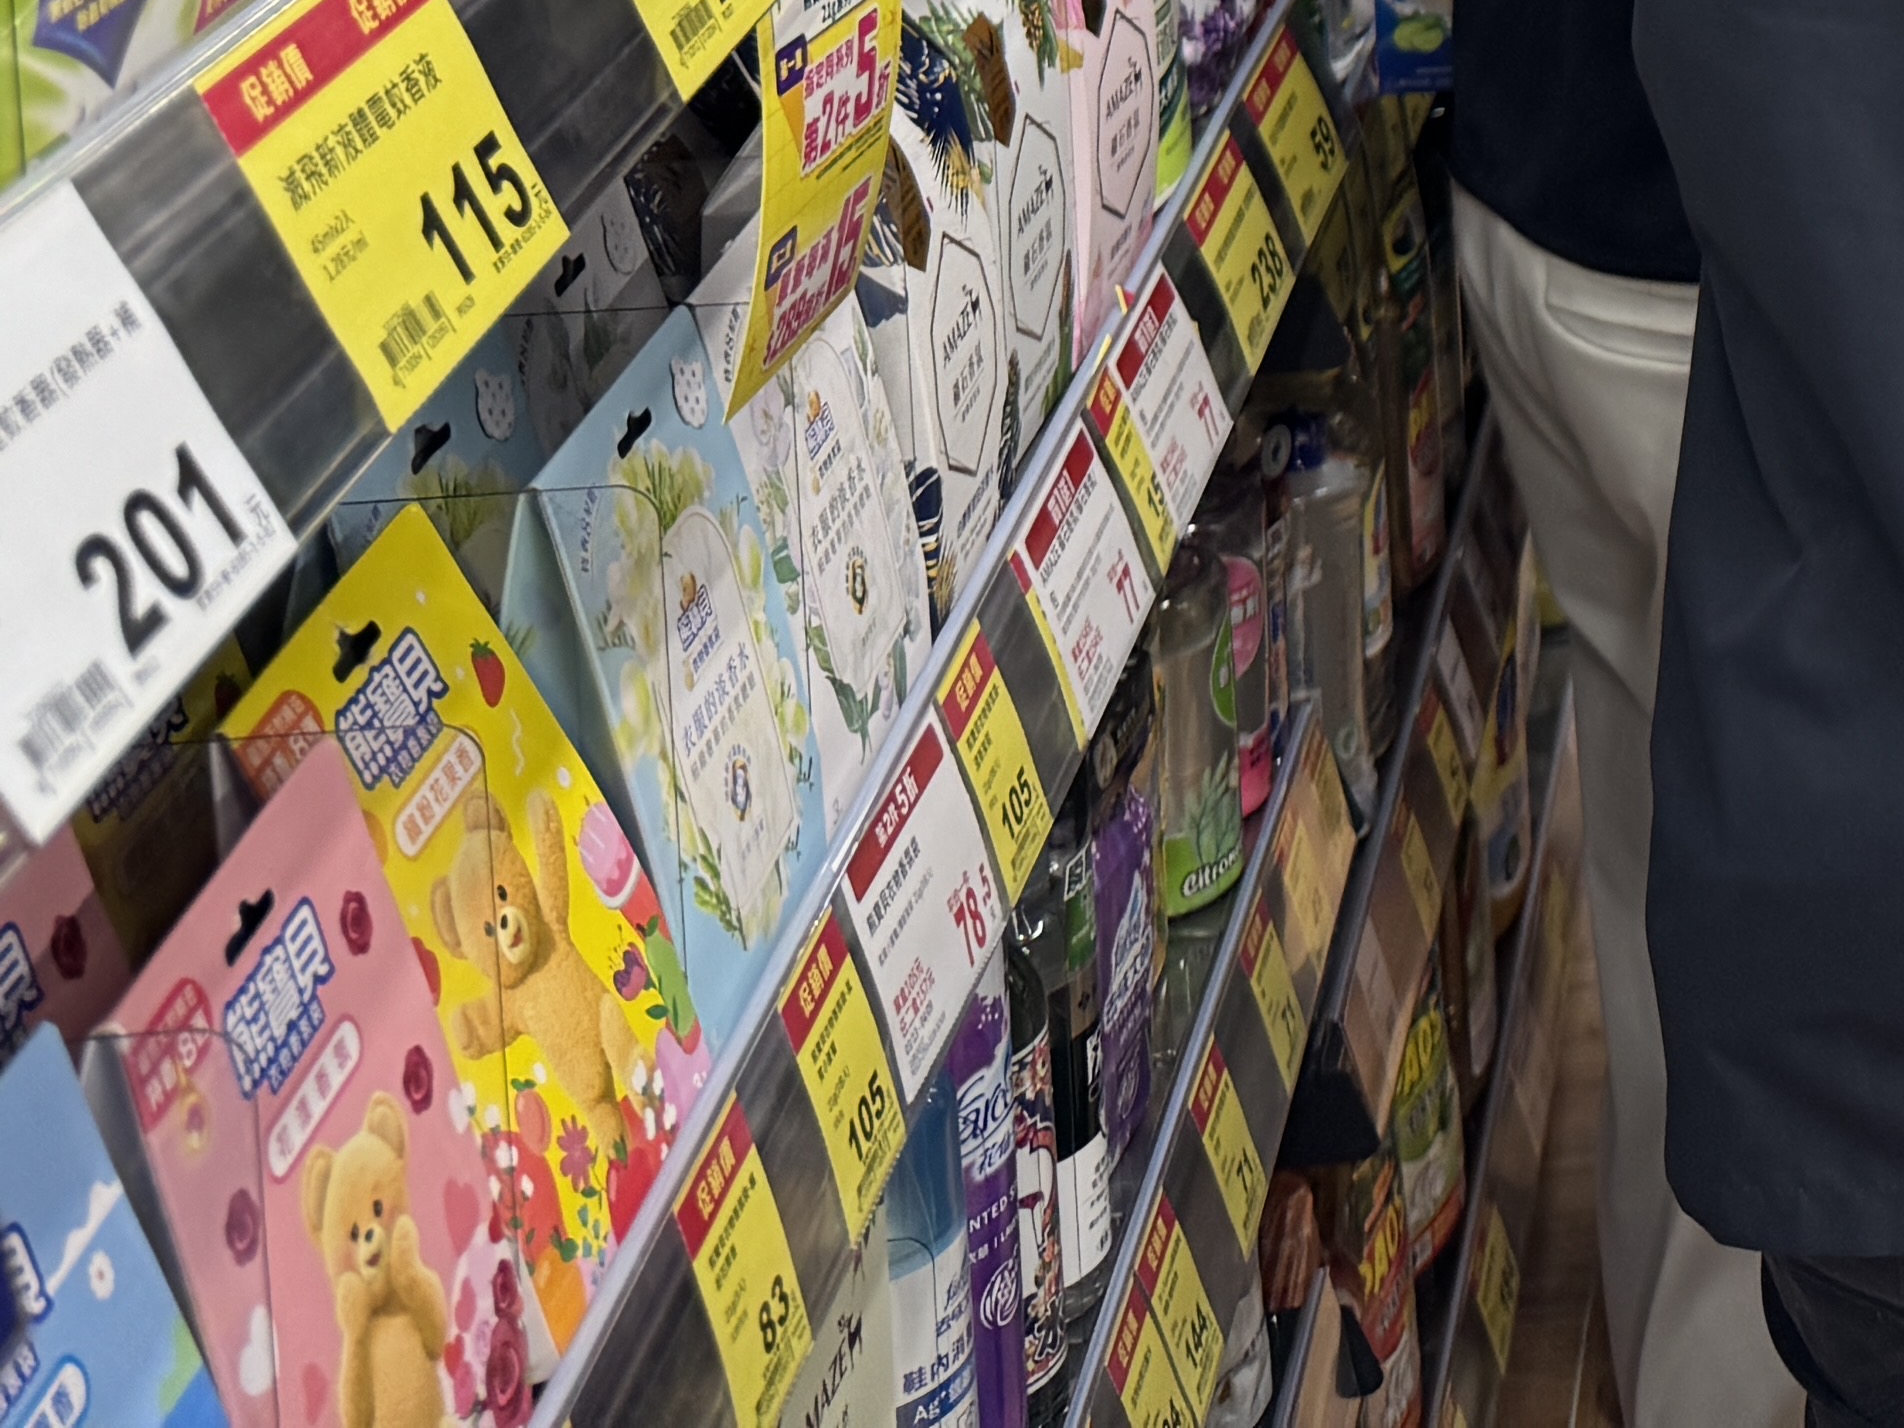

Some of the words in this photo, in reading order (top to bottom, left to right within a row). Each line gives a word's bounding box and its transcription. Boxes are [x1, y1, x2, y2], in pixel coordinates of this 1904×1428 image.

[239, 42, 316, 124] 促銷價
[74, 444, 244, 657] 201
[1115, 561, 1140, 625] 77
[334, 626, 450, 792] 熊寶貝
[1001, 765, 1032, 840] 105
[224, 897, 336, 1101] 熊寶貝
[848, 1068, 886, 1162] 105
[758, 1274, 790, 1355] 83
